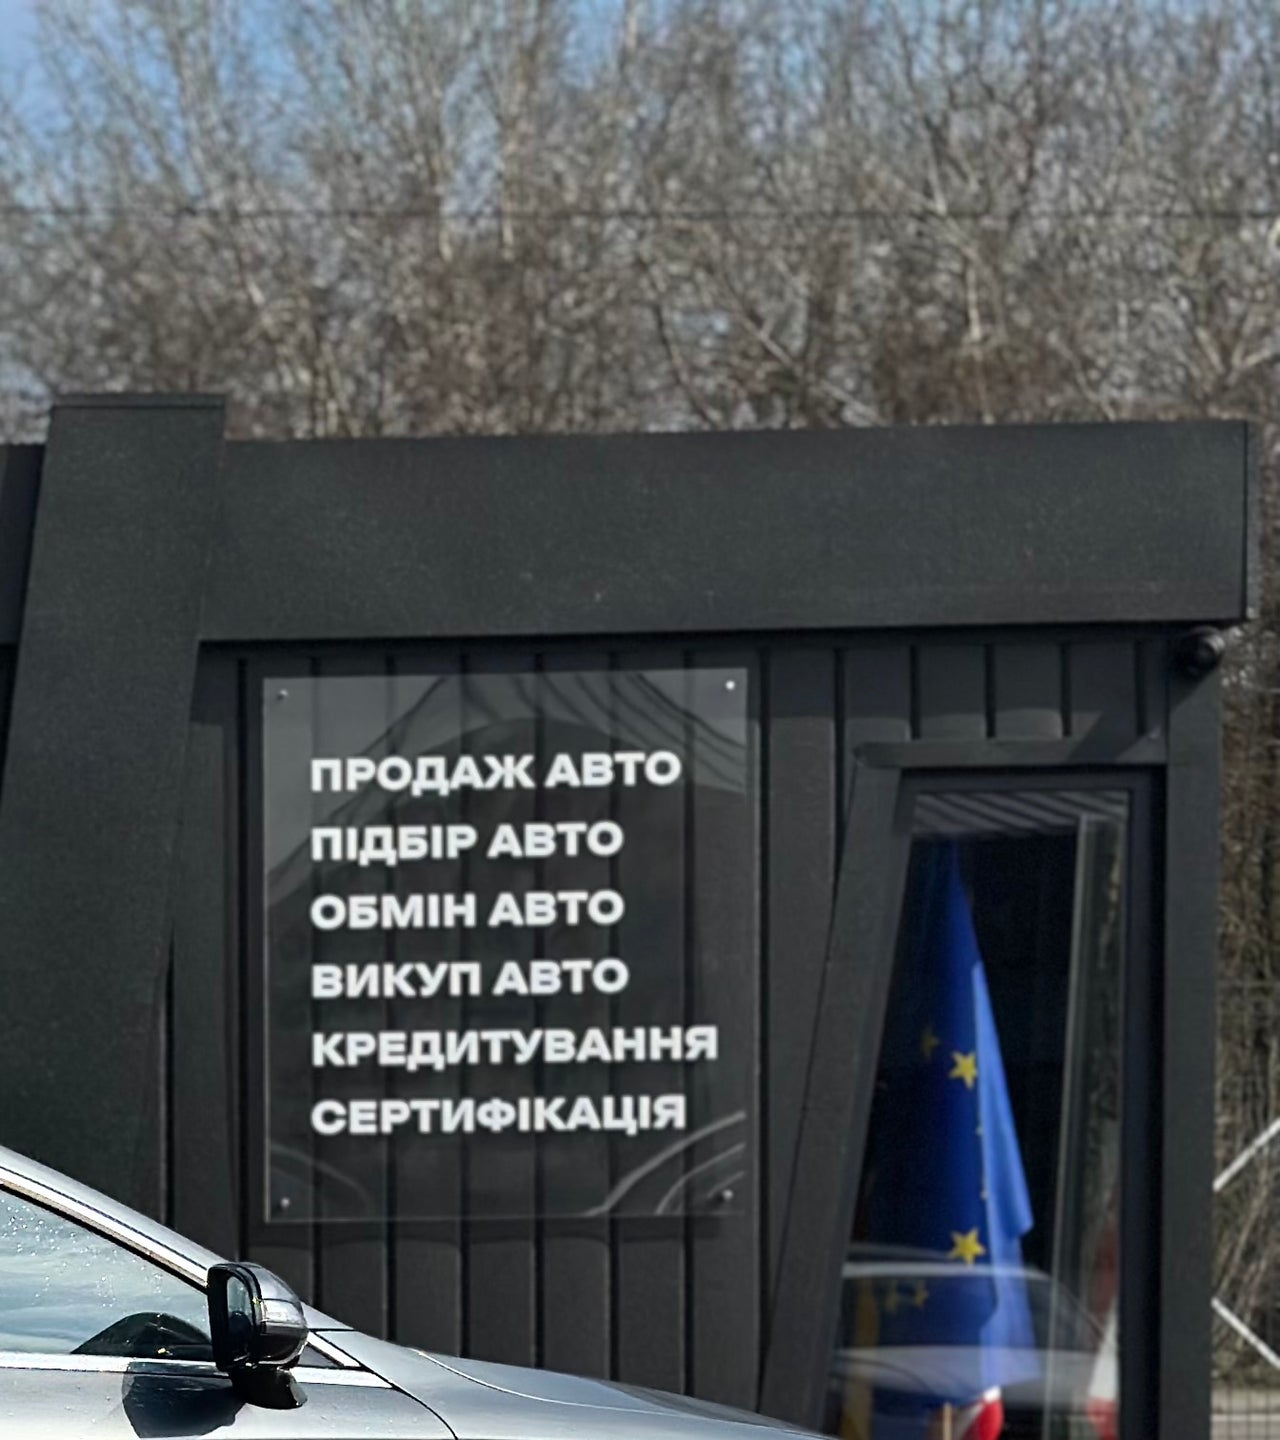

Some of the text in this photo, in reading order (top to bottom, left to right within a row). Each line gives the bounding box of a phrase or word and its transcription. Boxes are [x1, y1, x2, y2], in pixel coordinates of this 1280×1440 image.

[311, 751, 681, 796] ПРОДАЖ АВТО
[311, 821, 623, 866] ПІДБІР АВТО
[311, 890, 624, 929] ОБМІН АВТО
[313, 959, 628, 997] ВИКУП АВТО
[313, 1026, 717, 1071] КРЕДИТУВАННЯ
[312, 1095, 685, 1135] СЕРТИФІКАЦІЯ
